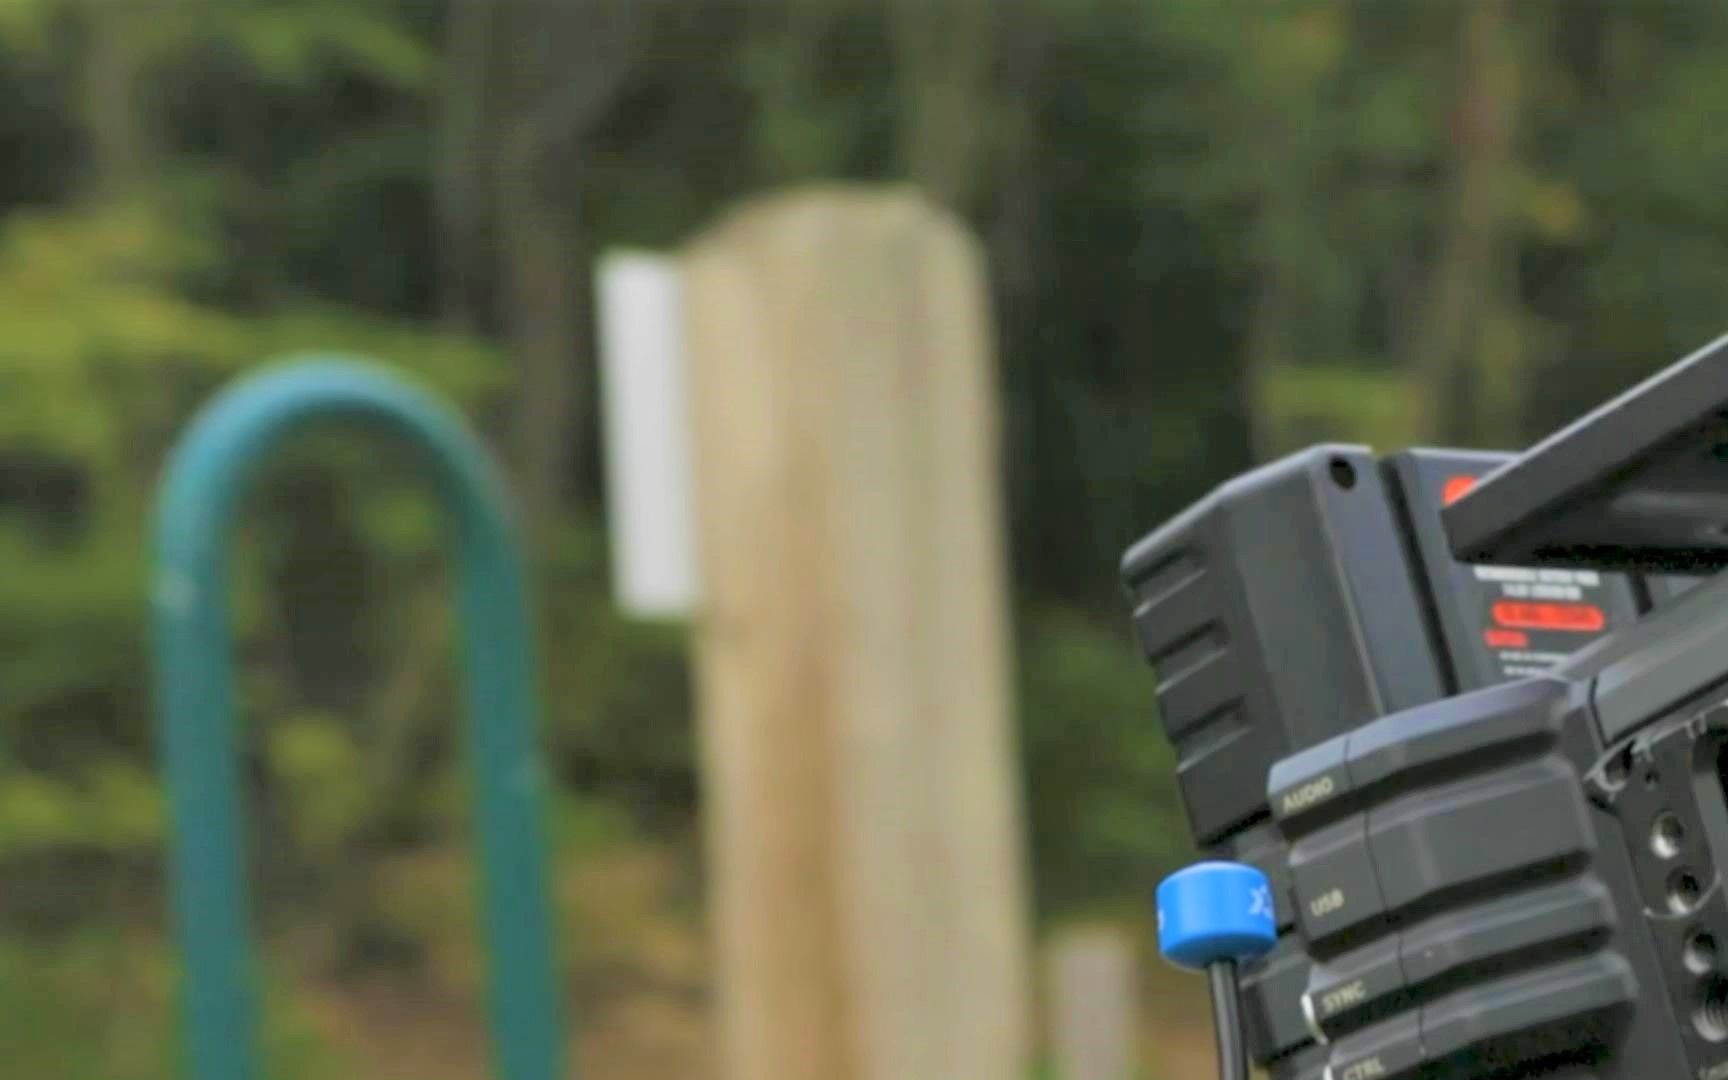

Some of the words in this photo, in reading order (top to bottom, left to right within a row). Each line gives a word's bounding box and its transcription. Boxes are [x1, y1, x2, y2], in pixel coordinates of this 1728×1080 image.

[1283, 776, 1334, 812] AUDIO
[1310, 888, 1345, 917] USB
[1322, 980, 1366, 1013] SYNC
